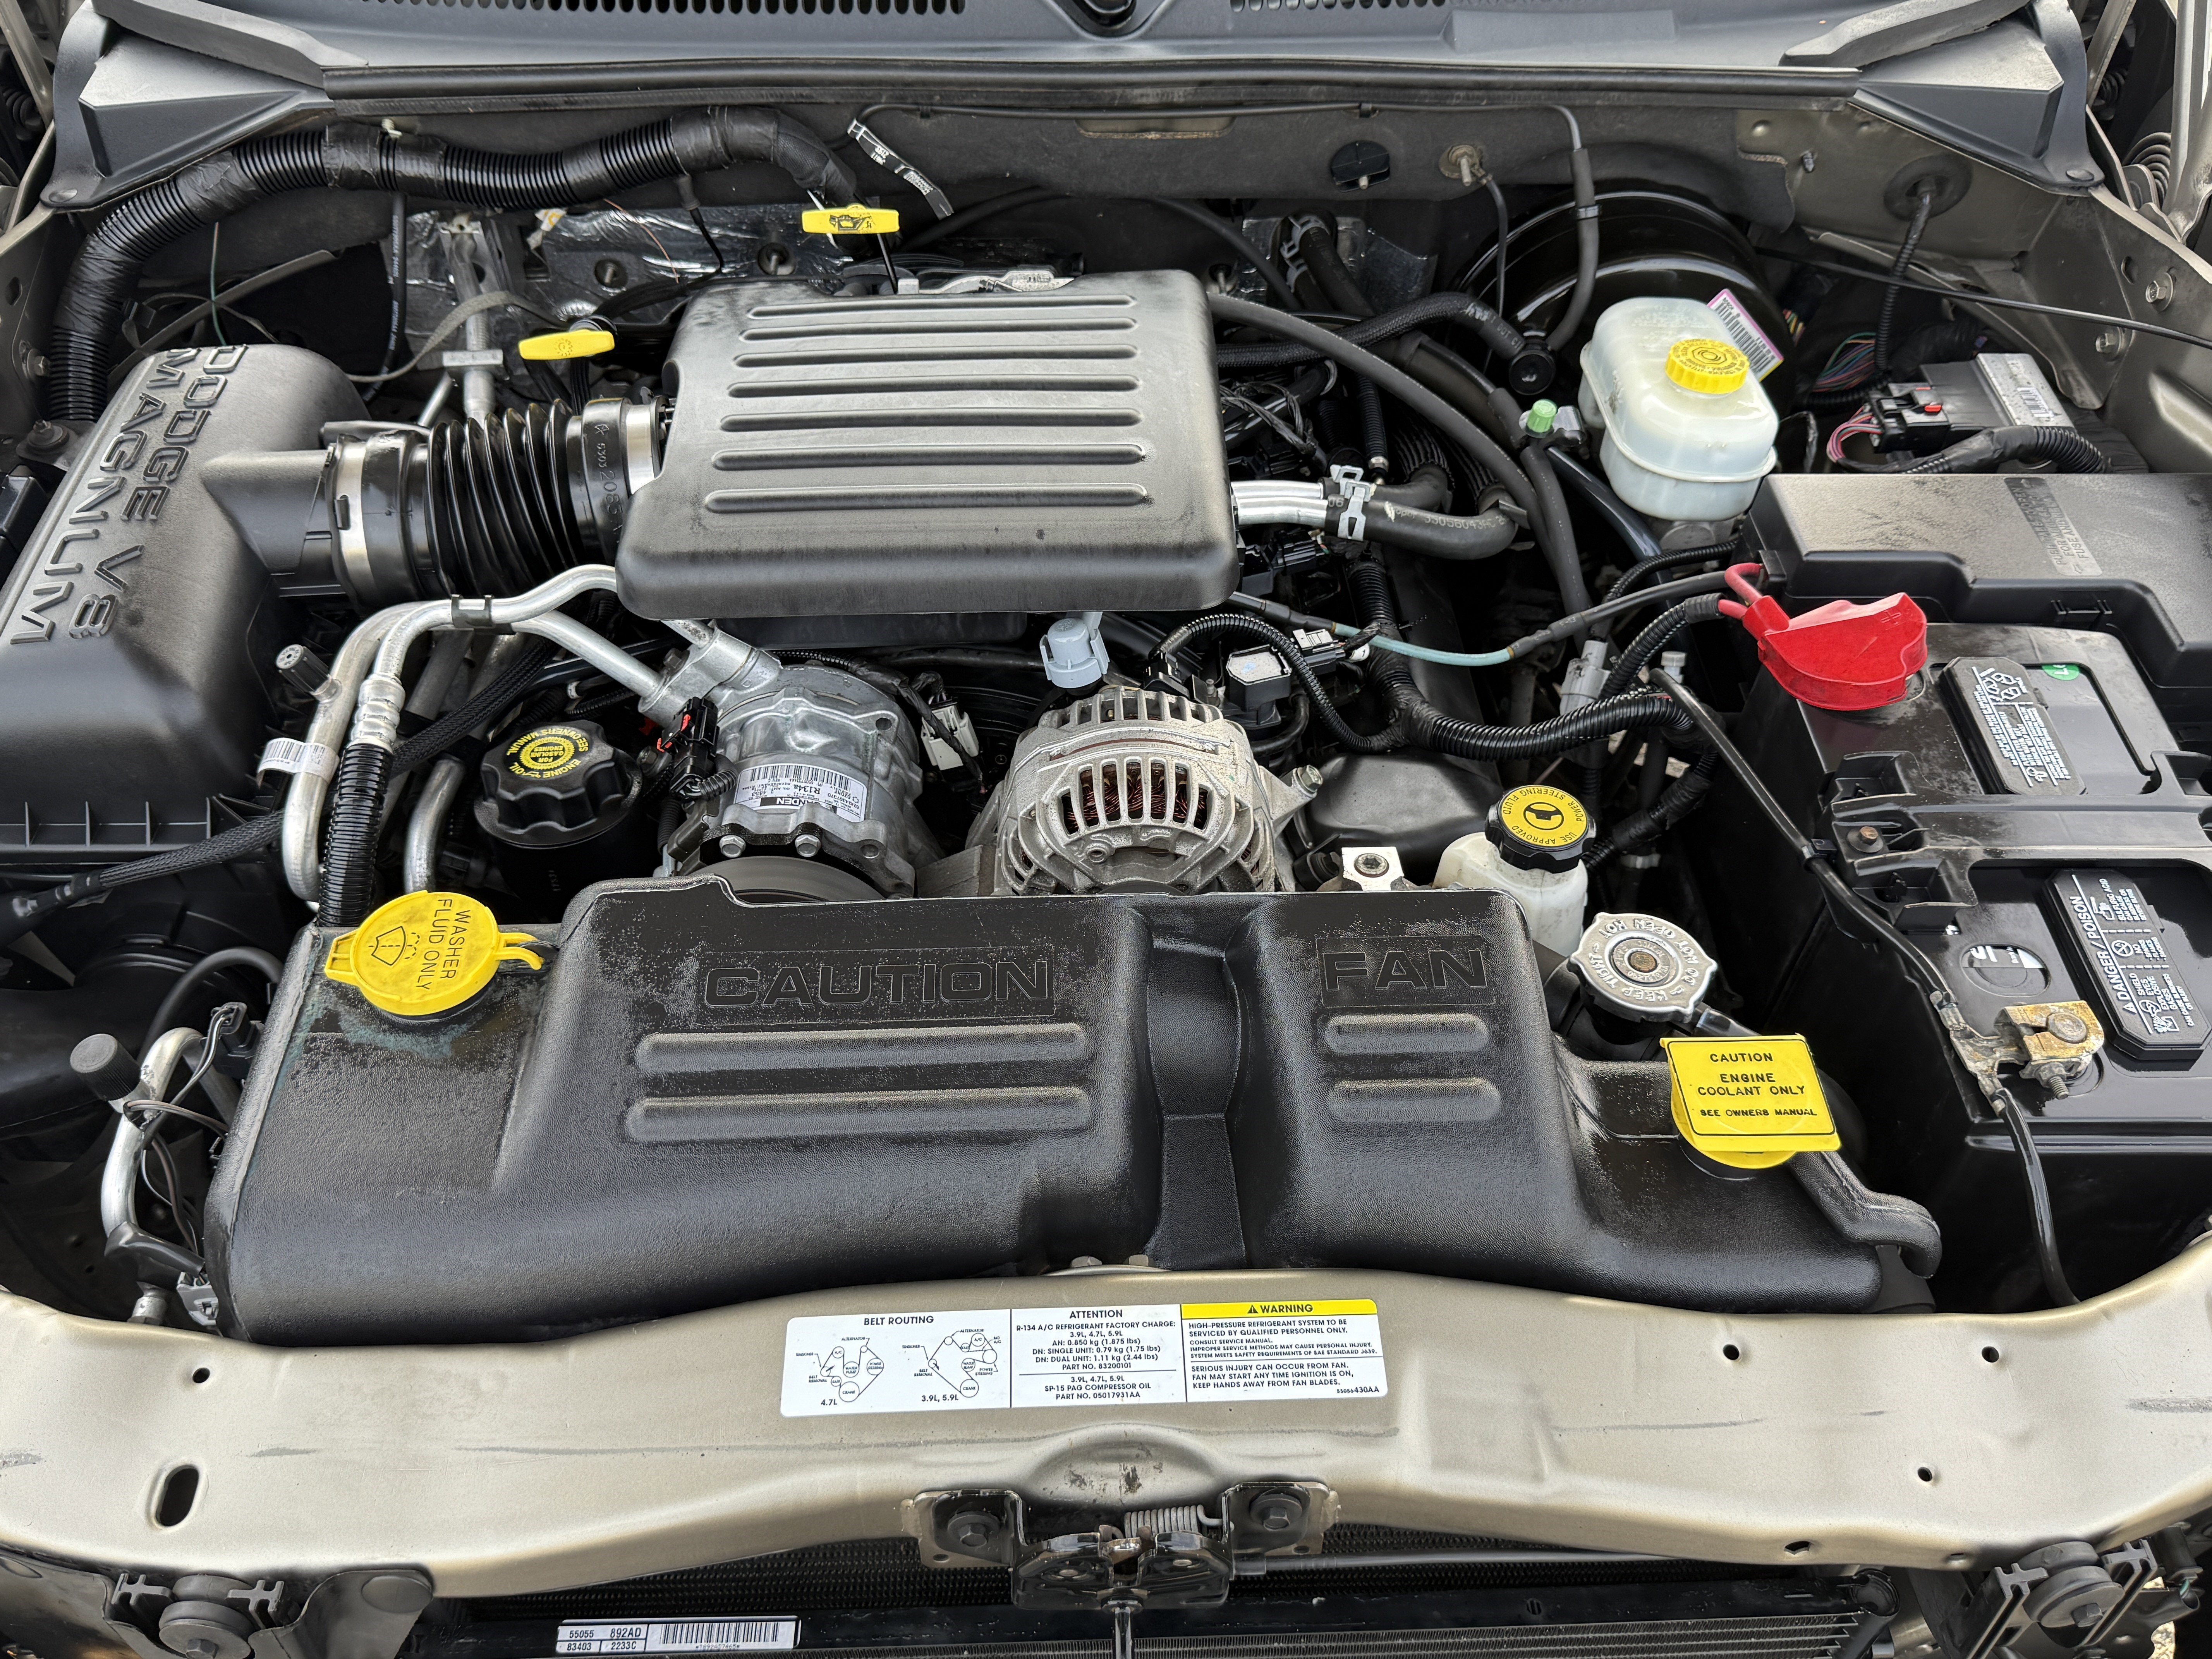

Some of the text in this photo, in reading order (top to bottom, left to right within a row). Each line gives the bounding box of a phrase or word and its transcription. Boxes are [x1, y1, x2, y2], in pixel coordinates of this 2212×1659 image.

[10, 347, 202, 644] MAGNUM
[68, 344, 249, 639] DODGE V8
[2067, 537, 2088, 558] FUSE
[506, 728, 589, 756] SEE OWNERS MANUAL
[508, 762, 525, 775] OIL
[543, 759, 581, 778] ENGINE
[793, 784, 821, 794] R134a
[1503, 788, 1585, 822] POWER STEERING FLUID
[1511, 825, 1577, 845] USE APPROVED
[2099, 878, 2112, 892] ACID
[416, 899, 452, 991] FLUID ONLY
[440, 910, 472, 979] WASHER
[2069, 896, 2131, 1000] DANGER POISON
[2132, 944, 2143, 954] NO
[1323, 950, 1487, 991] FAN
[704, 960, 1049, 1006] CAUTION
[2129, 973, 2145, 996] SHIELD
[2140, 979, 2154, 996] EYES
[1711, 1053, 1772, 1062] CAUTION
[1720, 1073, 1775, 1082] ENGINE
[1698, 1086, 1804, 1096] COOLANT ONLY
[1070, 1310, 1122, 1318] ATTENTION
[1260, 1304, 1313, 1314] WARNING
[889, 1316, 934, 1324] ROUTING
[569, 1628, 641, 1638] 55055 892AD
[567, 1641, 637, 1650] 83403 2233C
